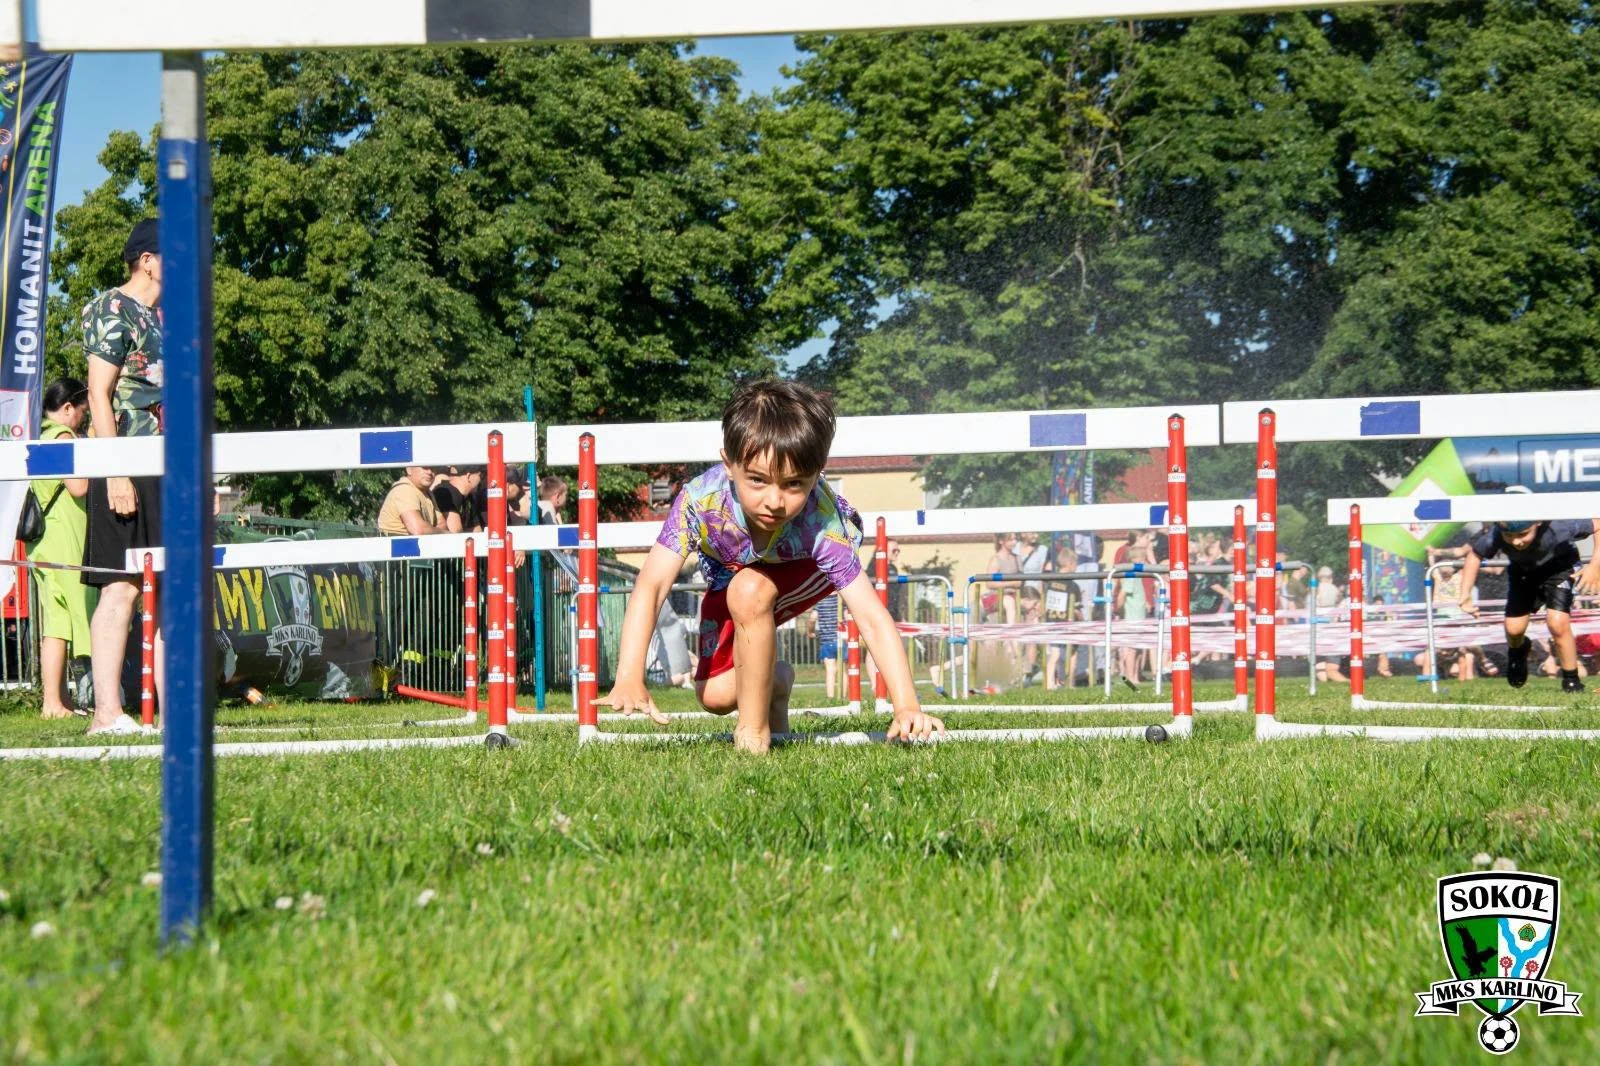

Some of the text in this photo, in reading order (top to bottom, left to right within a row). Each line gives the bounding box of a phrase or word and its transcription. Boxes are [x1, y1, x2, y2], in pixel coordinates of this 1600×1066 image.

[14, 101, 56, 375] HOMANIT ARENA
[1534, 448, 1600, 483] ME
